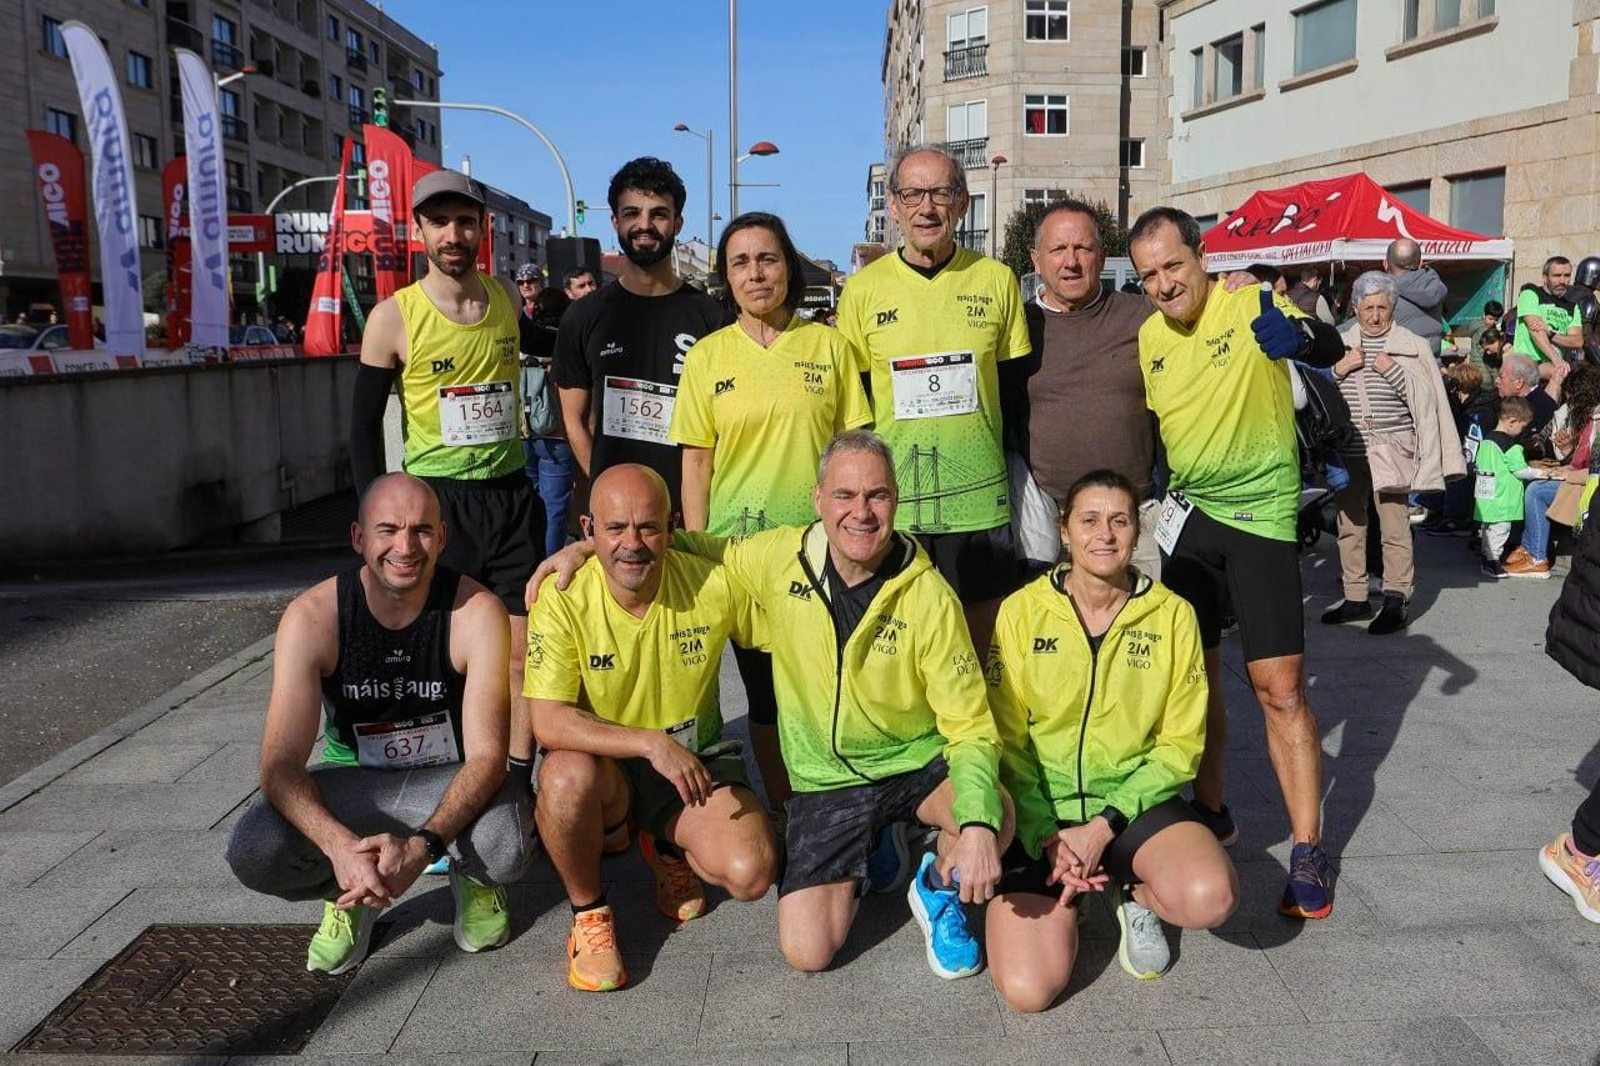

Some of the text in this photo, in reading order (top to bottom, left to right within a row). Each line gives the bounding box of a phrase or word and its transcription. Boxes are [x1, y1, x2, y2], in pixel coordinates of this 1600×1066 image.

[275, 213, 328, 232] RUN
[876, 308, 899, 326] DK
[967, 319, 987, 329] VIGO
[431, 357, 456, 373] DK
[714, 377, 736, 395] DK
[928, 374, 941, 393] 8
[459, 401, 504, 421] 1564
[620, 396, 663, 420] 1562
[788, 581, 815, 600] DK
[870, 643, 897, 656] VIGO
[1033, 638, 1059, 651] DK
[589, 654, 615, 669] DK
[681, 653, 707, 667] VIGO
[1126, 658, 1151, 670] VIGO
[343, 679, 391, 700] máis
[406, 680, 448, 701] aug
[384, 734, 425, 759] 637
